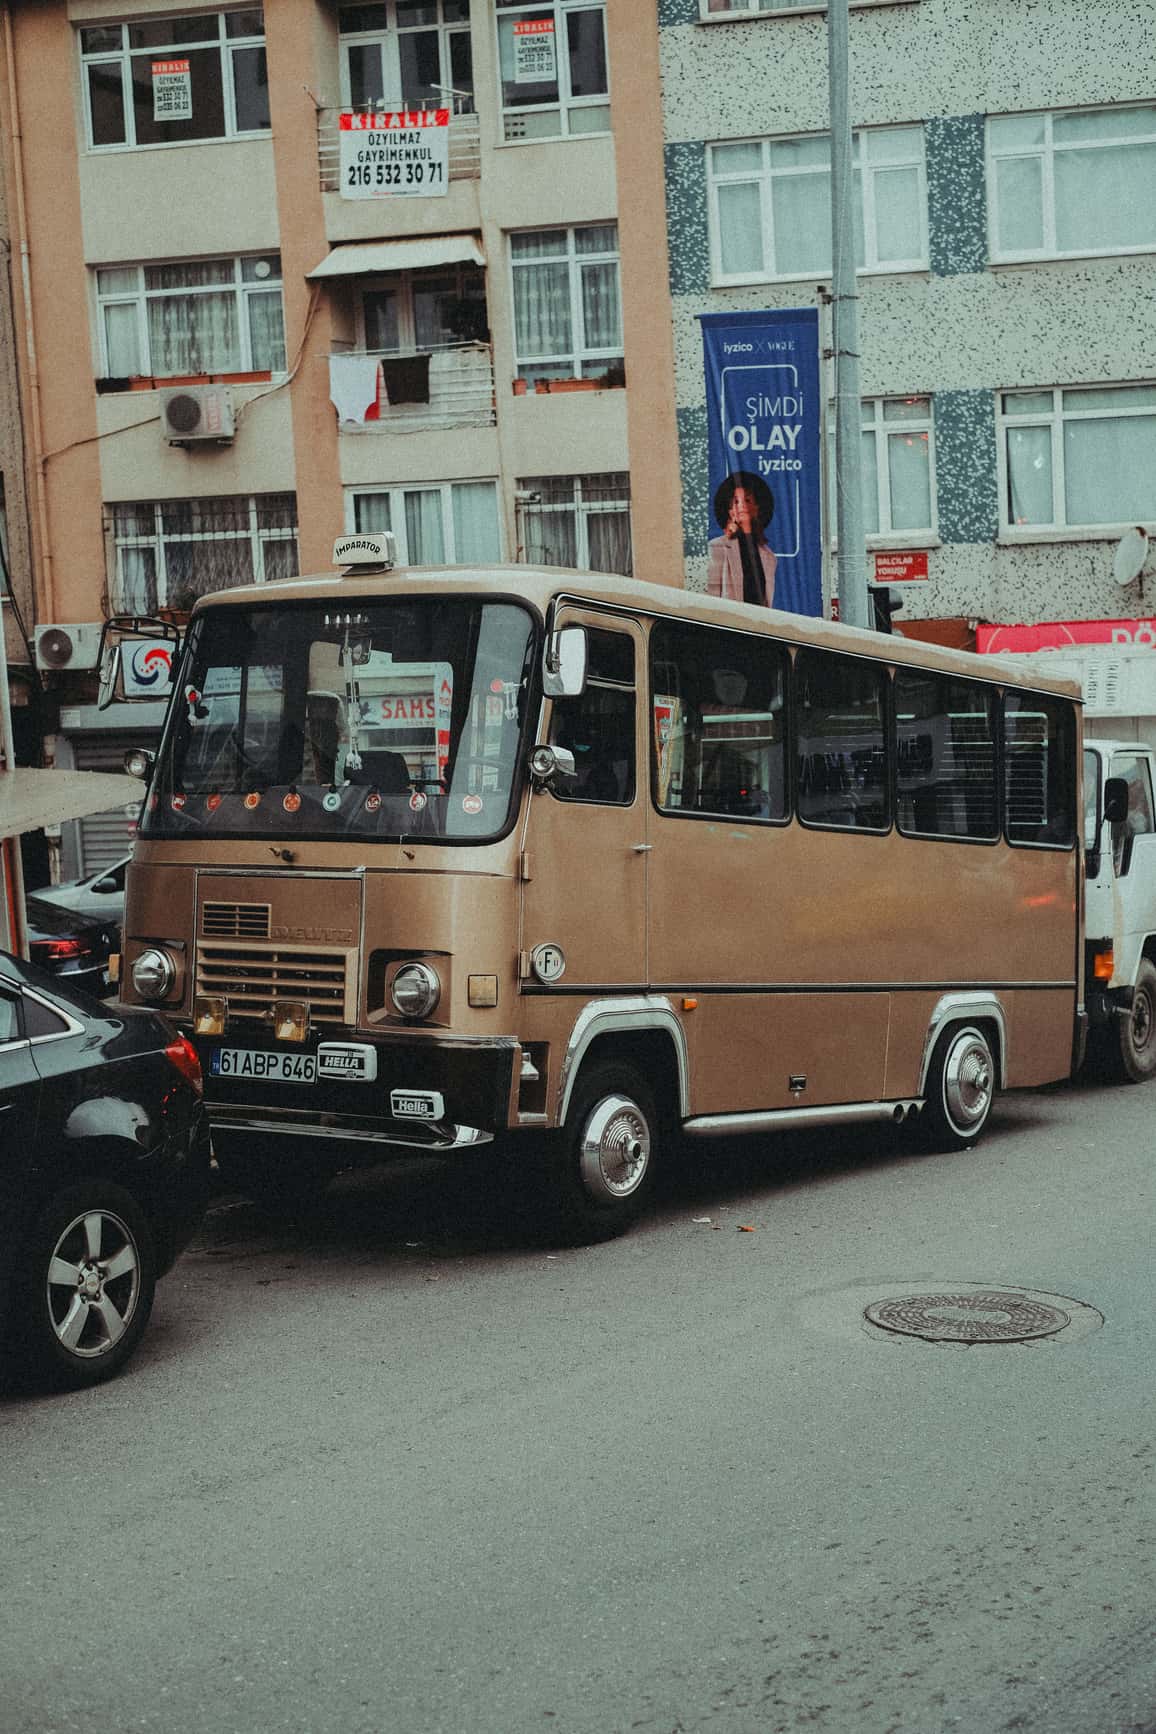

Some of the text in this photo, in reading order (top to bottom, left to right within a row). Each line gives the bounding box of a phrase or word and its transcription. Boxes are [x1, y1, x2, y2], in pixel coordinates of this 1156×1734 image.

[351, 112, 437, 129] KIRALIK
[368, 131, 421, 146] ÖZYILMAZ
[357, 147, 432, 162] GAYRİMENKUL
[348, 162, 443, 186] 216 532 30 71
[723, 342, 753, 354] iyzico
[745, 392, 804, 423] ŞİMDİ
[727, 424, 803, 451] OLAY
[758, 455, 802, 475] iyzico
[282, 1056, 314, 1080] 646
[324, 1056, 359, 1069] HELLA
[399, 1101, 428, 1113] Hella
